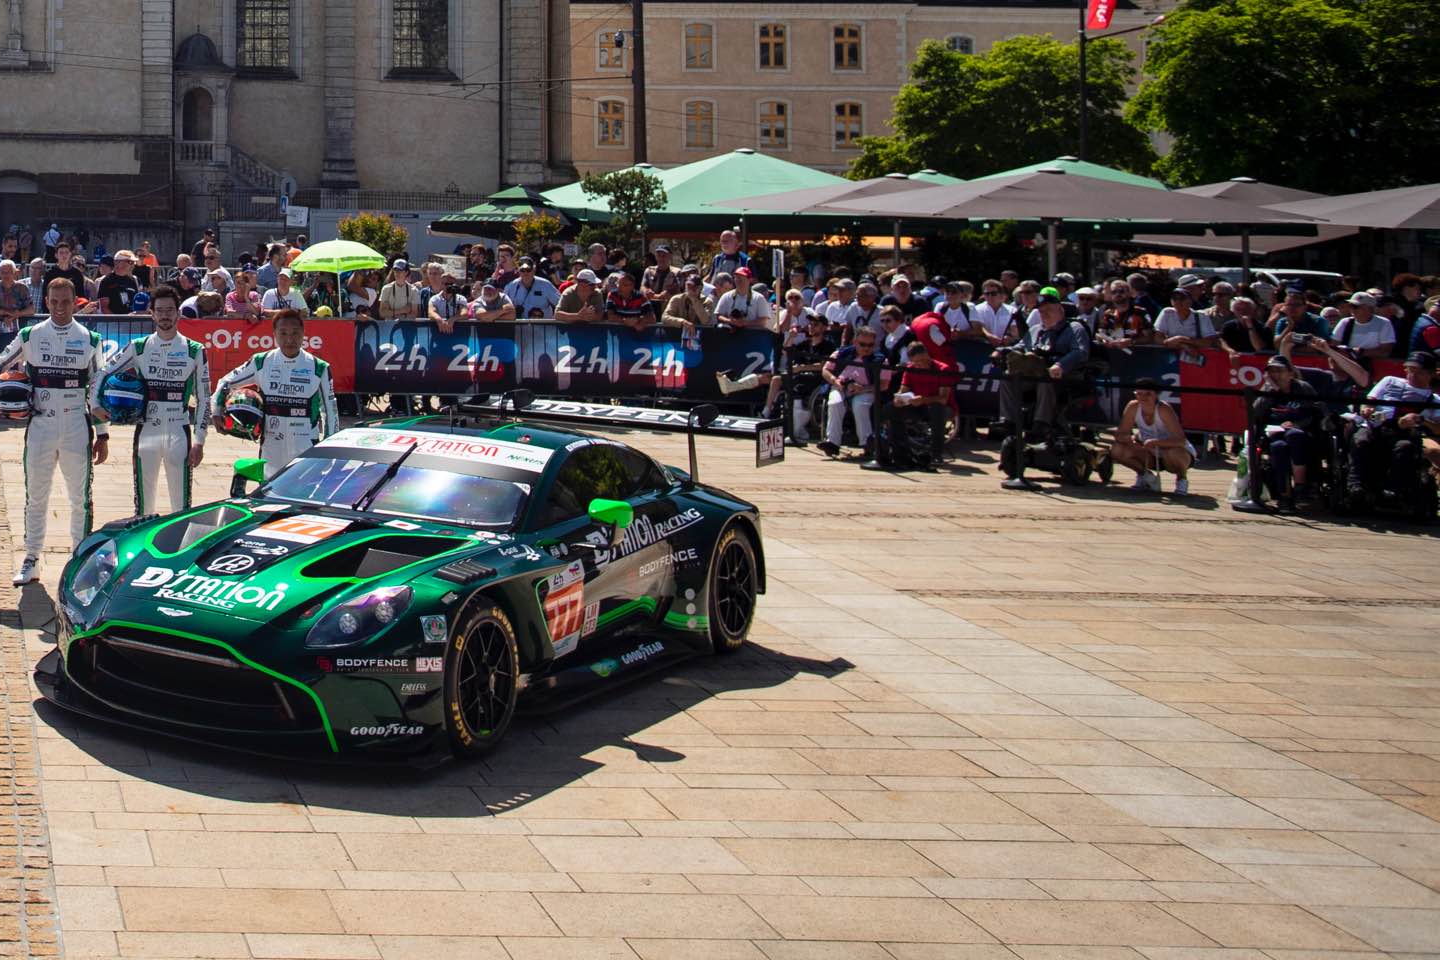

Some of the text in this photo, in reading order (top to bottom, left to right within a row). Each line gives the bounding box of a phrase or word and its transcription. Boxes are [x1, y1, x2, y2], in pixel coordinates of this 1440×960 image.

[247, 333, 323, 349] cose
[653, 507, 701, 540] RACING
[639, 547, 698, 577] BODYFENCE
[153, 588, 238, 610] RACING
[544, 590, 584, 640] 777
[336, 658, 409, 667] BODYFENCE
[416, 656, 443, 672] HEXIS
[350, 723, 424, 737] GOODYEAR
